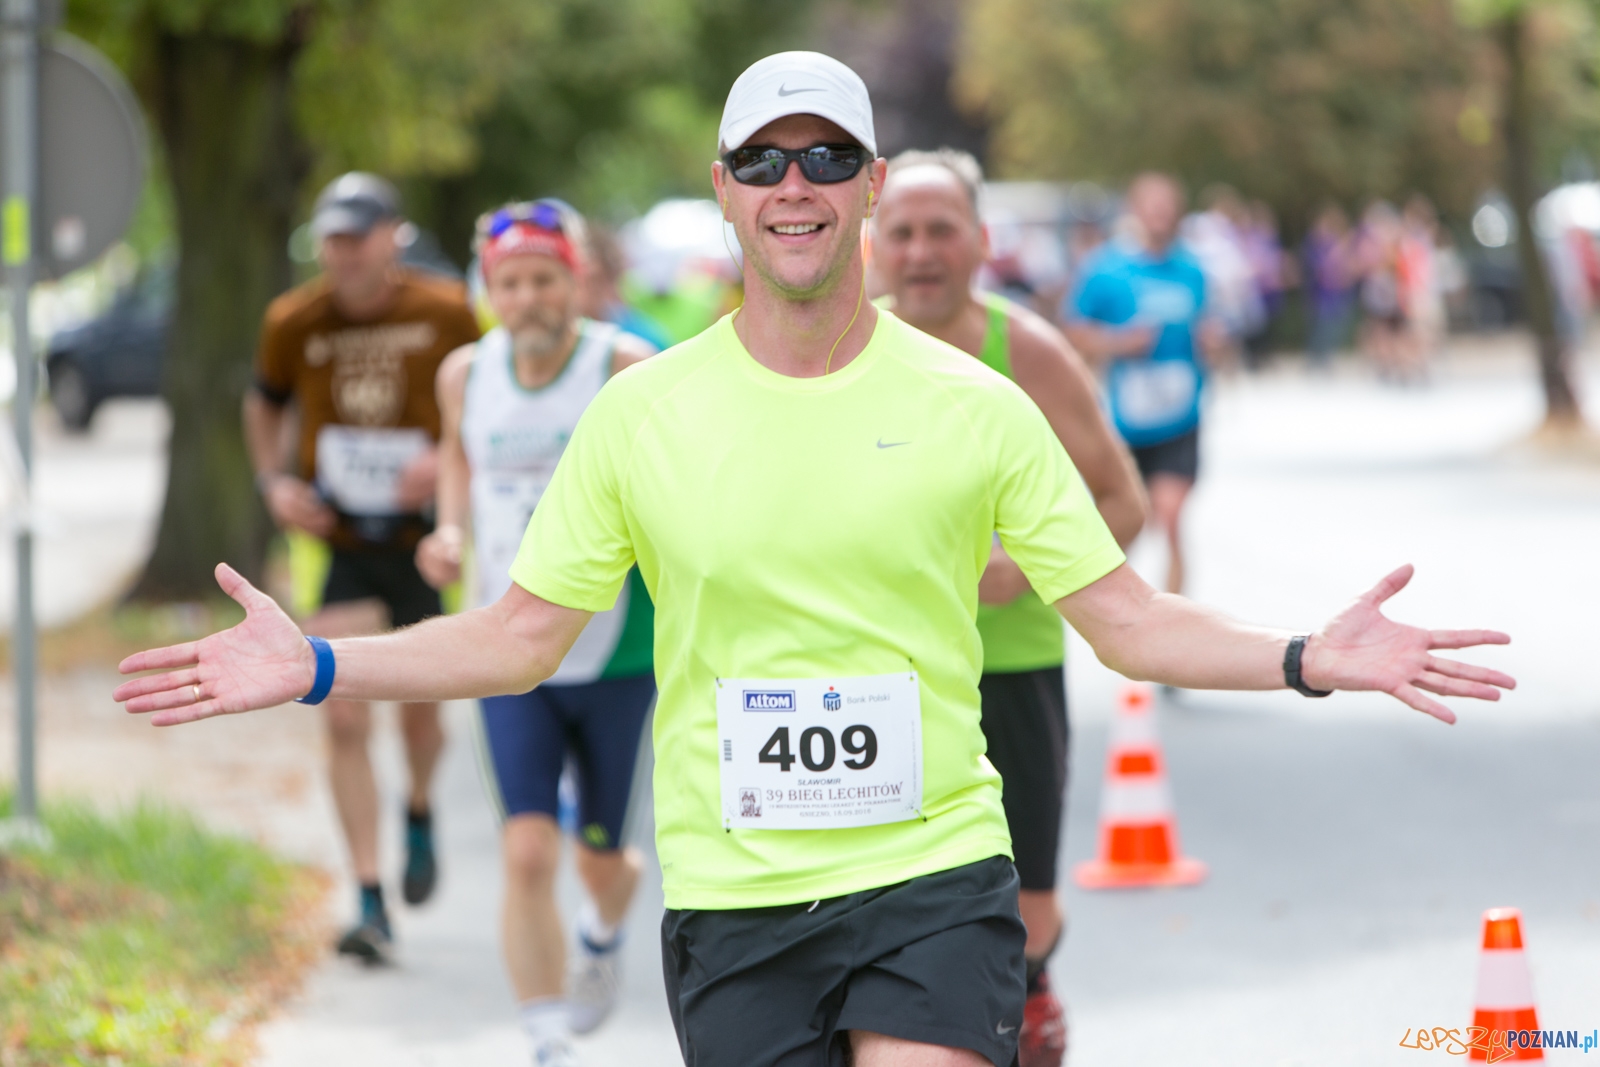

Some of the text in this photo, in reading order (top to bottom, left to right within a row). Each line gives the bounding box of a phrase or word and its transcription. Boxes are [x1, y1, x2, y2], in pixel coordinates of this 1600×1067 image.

[846, 694, 890, 704] Bank Polski
[758, 724, 878, 772] 409
[797, 778, 841, 786] SŁAWOMIR
[765, 781, 904, 802] 39 BIEG LECHITÓW
